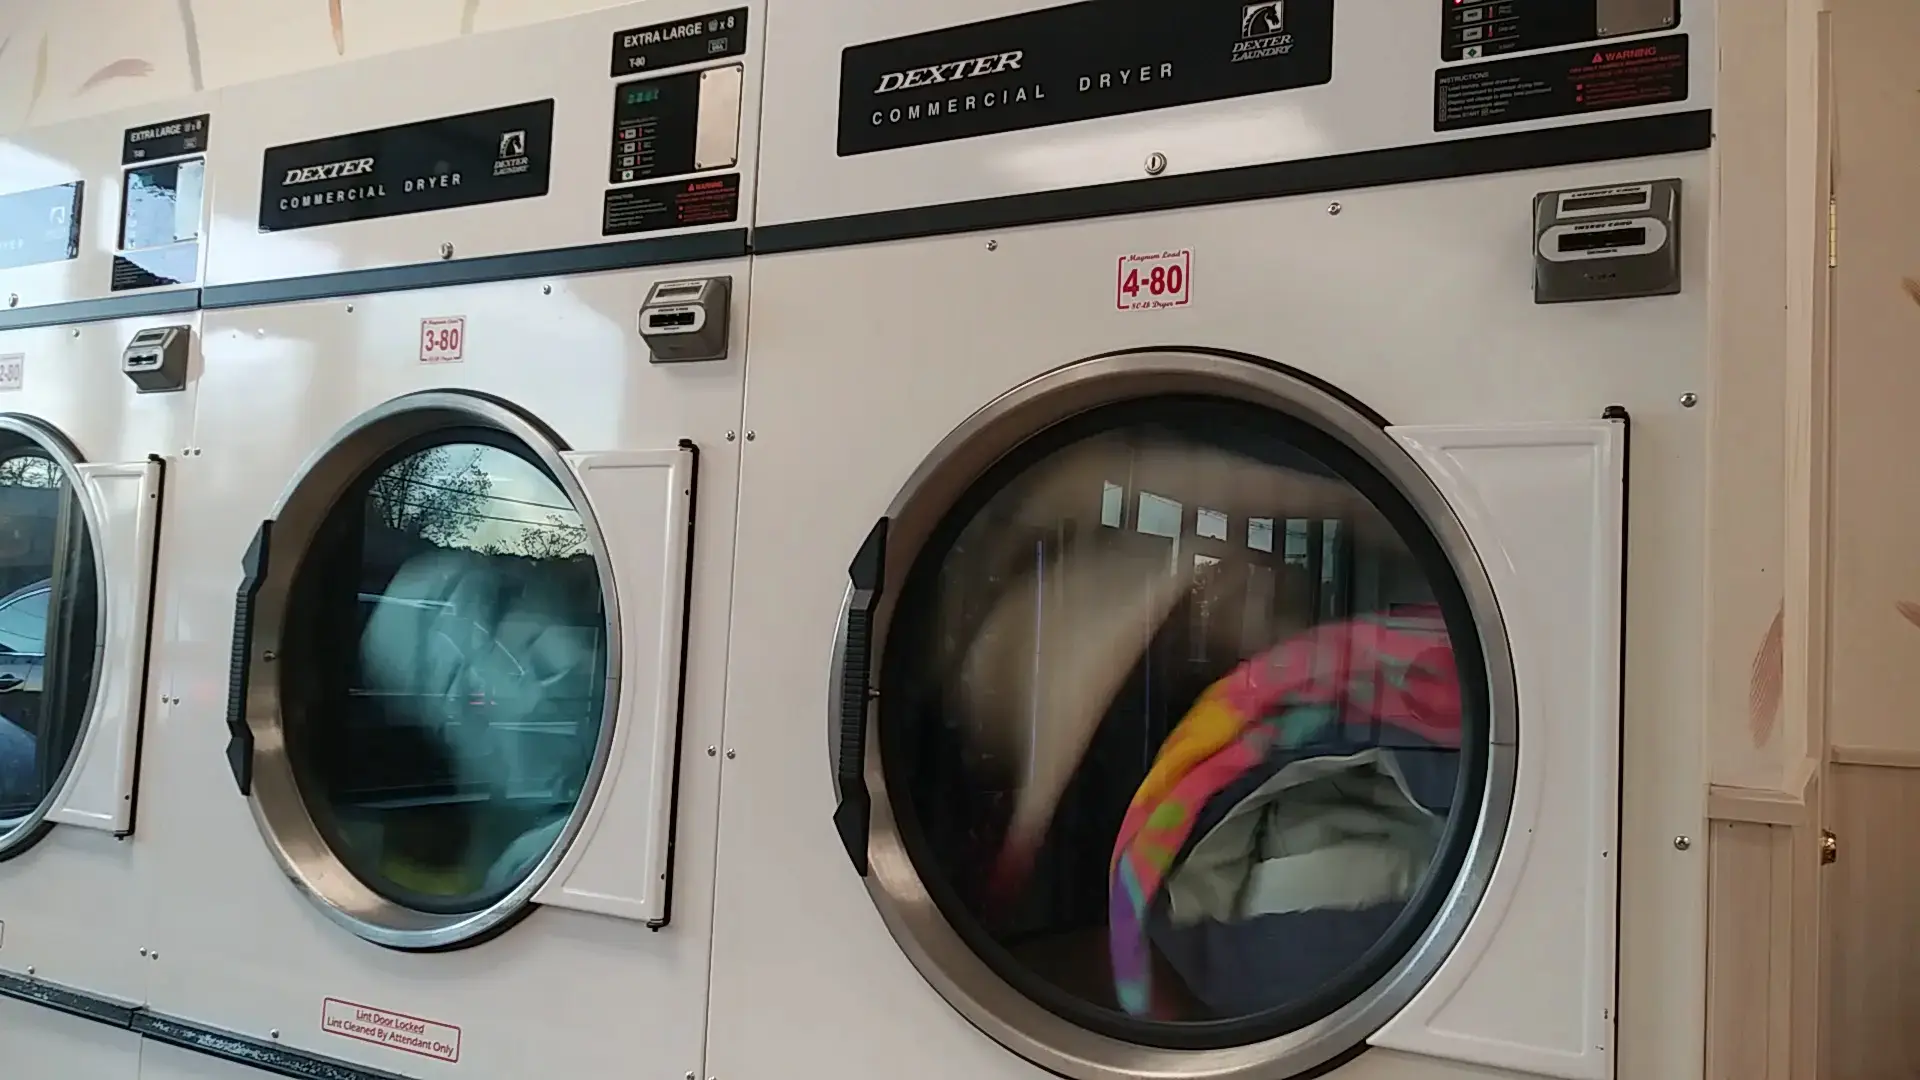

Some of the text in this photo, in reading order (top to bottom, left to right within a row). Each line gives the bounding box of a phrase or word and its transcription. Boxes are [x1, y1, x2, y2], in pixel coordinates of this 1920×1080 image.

[624, 31, 660, 48] EXTRA
[663, 22, 702, 40] LARGE
[727, 16, 735, 28] 8
[1232, 34, 1292, 53] DEXTER
[628, 56, 646, 68] T-80
[1231, 44, 1294, 62] LAUNDRY
[1605, 46, 1657, 61] WARNING
[872, 50, 1024, 95] DEXTER
[1439, 71, 1489, 84] INSTRUCTIONS
[871, 62, 1174, 127] COMMERCIAL DRYER
[131, 130, 155, 142] EXTRA
[155, 124, 182, 138] LARGE
[282, 157, 376, 186] DEXTER
[279, 172, 463, 211] COMMERCIAL DRYER
[1127, 250, 1181, 262] Magnum Load
[1122, 264, 1183, 298] 4-80
[425, 328, 458, 351] 3-80
[355, 1009, 425, 1034] Lint Door Locked
[327, 1016, 454, 1058] Lint Cleaned By Attendant Only
